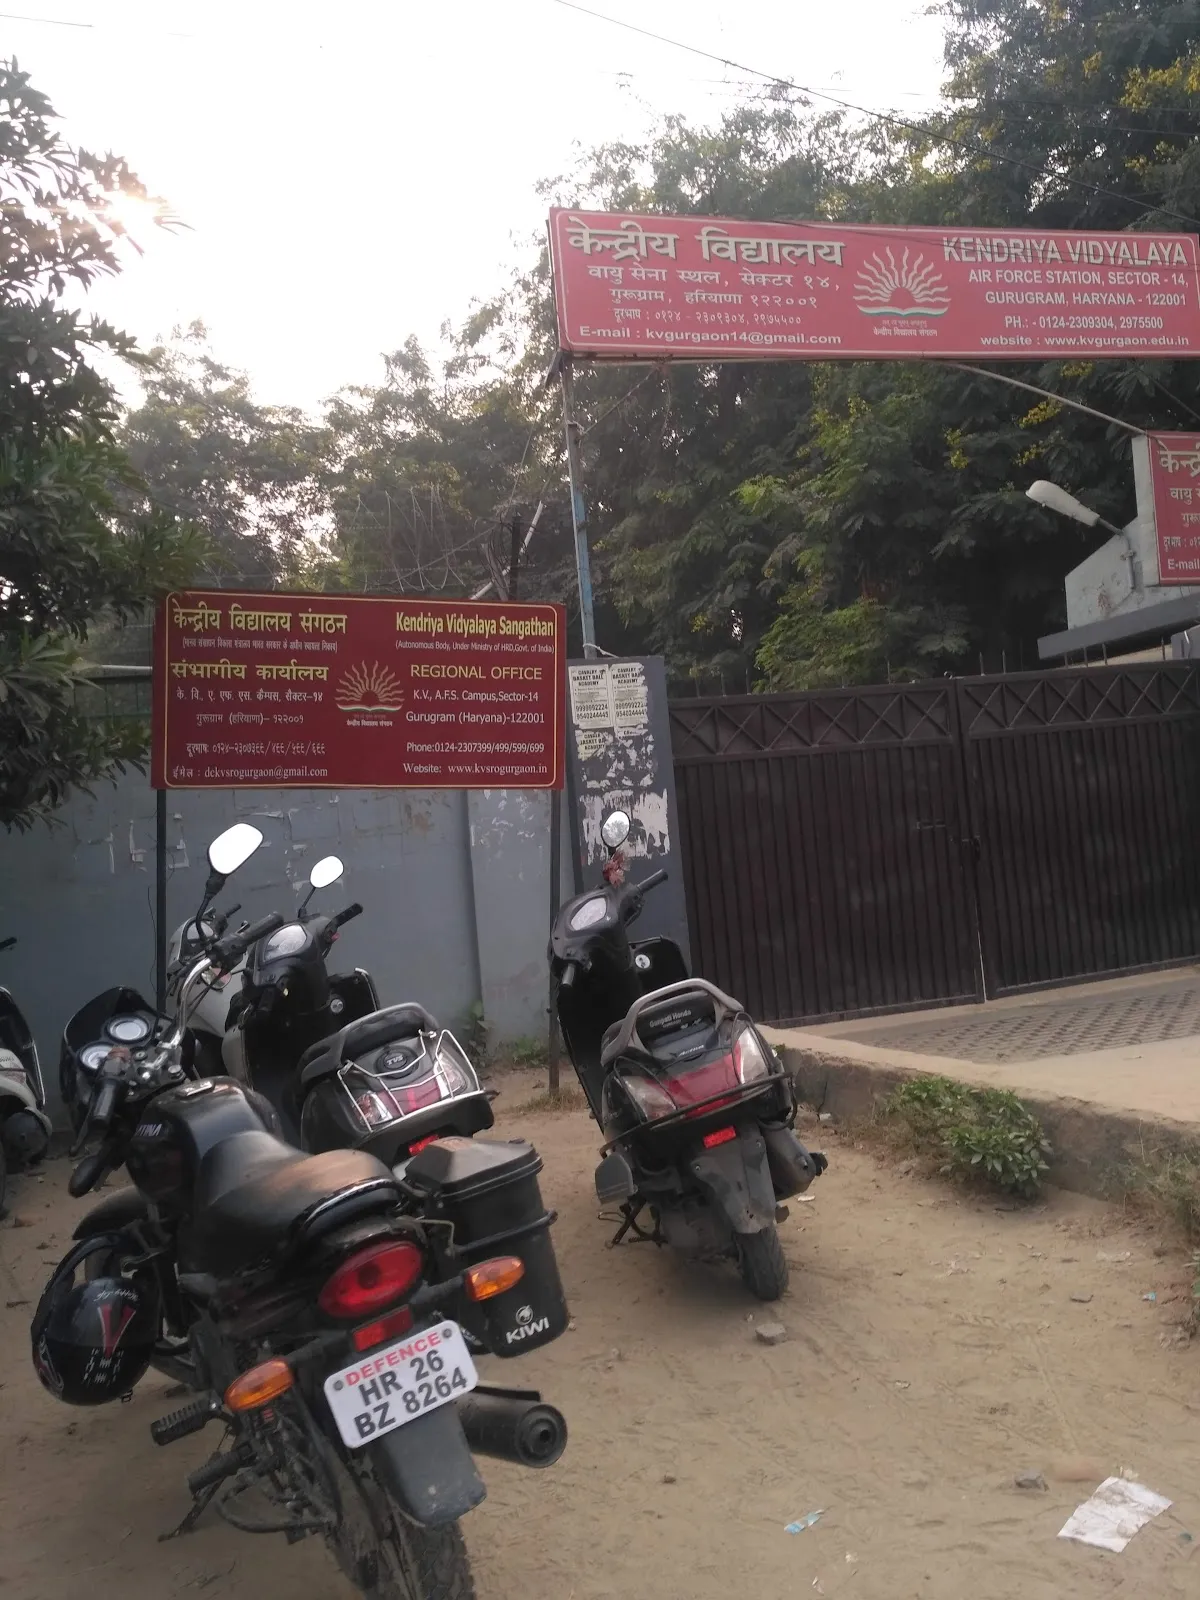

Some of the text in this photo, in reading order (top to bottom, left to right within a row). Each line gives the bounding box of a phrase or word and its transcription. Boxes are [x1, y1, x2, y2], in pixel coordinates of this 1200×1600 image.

[566, 216, 846, 266] केन्द्रीय विद्यालय
[942, 236, 1188, 267] KENDRIYA VIDYALAYA
[587, 263, 841, 291] वायु सेना स्थल, सेक्टर १४,
[968, 269, 993, 283] AIR
[995, 269, 1043, 285] FORCE
[1045, 270, 1106, 287] STATION,
[1107, 272, 1161, 286] SECTOR
[1170, 272, 1189, 288] 14,
[684, 289, 743, 306] हरियाणा
[750, 294, 818, 309] १२२००१
[985, 291, 1070, 308] GURUGRAM,
[1072, 291, 1135, 306] HARYANA
[1145, 293, 1187, 306] 122001
[655, 310, 682, 324] ०१२४
[1039, 316, 1118, 331] 0124-2309304,
[1120, 316, 1163, 330] 2975500
[579, 325, 631, 339] E-mail
[646, 327, 842, 346] kvgurgaon14@gmail.com
[980, 335, 1033, 347] website
[1044, 335, 1190, 348] www.kvgurgaon.edu.in
[1170, 488, 1193, 505] वायु
[171, 598, 348, 634] केन्द्रीय विद्यालय संगठन
[395, 612, 554, 640] Kendriya Vidyalaya Sangathan
[395, 639, 435, 651] (Autonomous
[435, 640, 451, 652] Body,
[452, 641, 469, 651] Under
[470, 641, 493, 652] Ministry
[537, 644, 555, 654] India)
[170, 658, 330, 681] संभागीय कार्यालय
[410, 664, 543, 680] REGIONAL OFFICE
[434, 689, 459, 701] A.F.S.
[273, 714, 305, 725] १२२००१
[406, 711, 545, 725] Gurugram (Haryana)-122001
[172, 765, 194, 780] ईमेल
[204, 765, 328, 780] dckvsrogurgaon@gmail.com
[403, 763, 548, 776] Website: www.kvsrogurgaon.in
[387, 1055, 404, 1066] TVS
[505, 1316, 550, 1344] KIWI
[345, 1331, 443, 1386] DEFENCE
[358, 1349, 445, 1406] HR 26
[354, 1366, 468, 1439] BZ 8264
